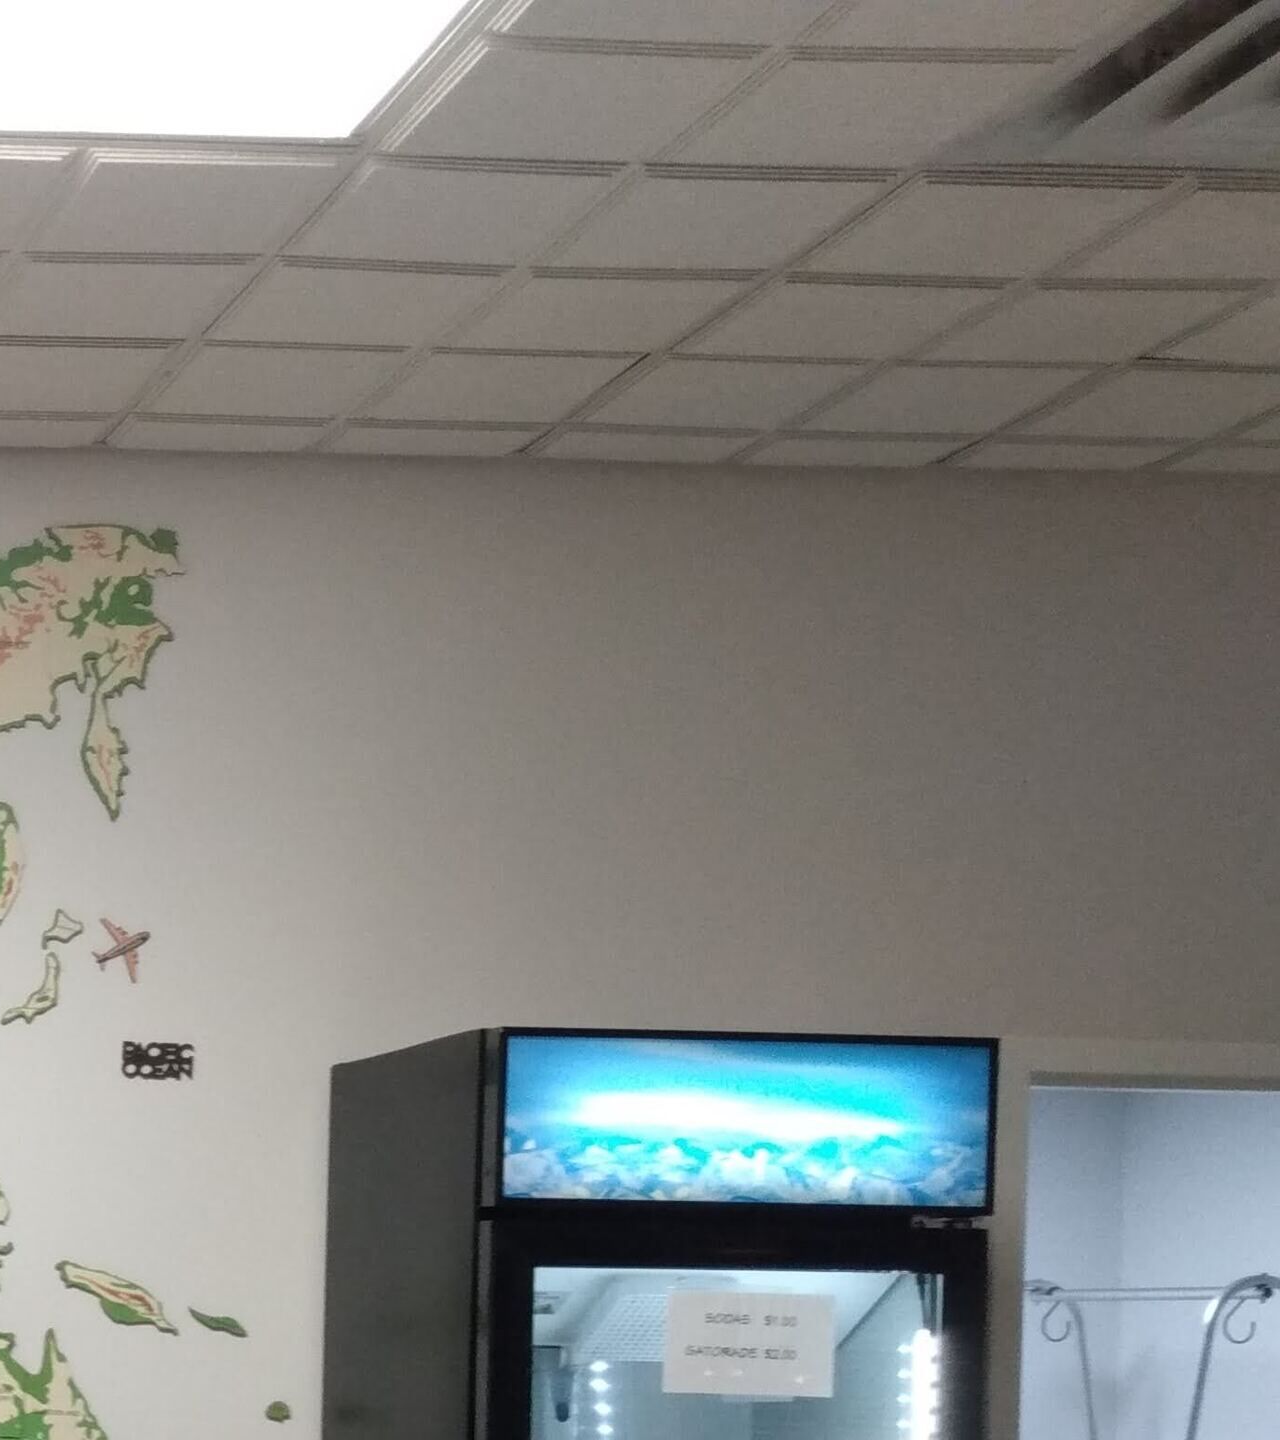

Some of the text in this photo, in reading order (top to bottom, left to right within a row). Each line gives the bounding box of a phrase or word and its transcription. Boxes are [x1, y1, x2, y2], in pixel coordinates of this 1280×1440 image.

[122, 1060, 193, 1080] OCEAN
[704, 1312, 751, 1325] SODAS
[685, 1345, 758, 1360] GATORADE
